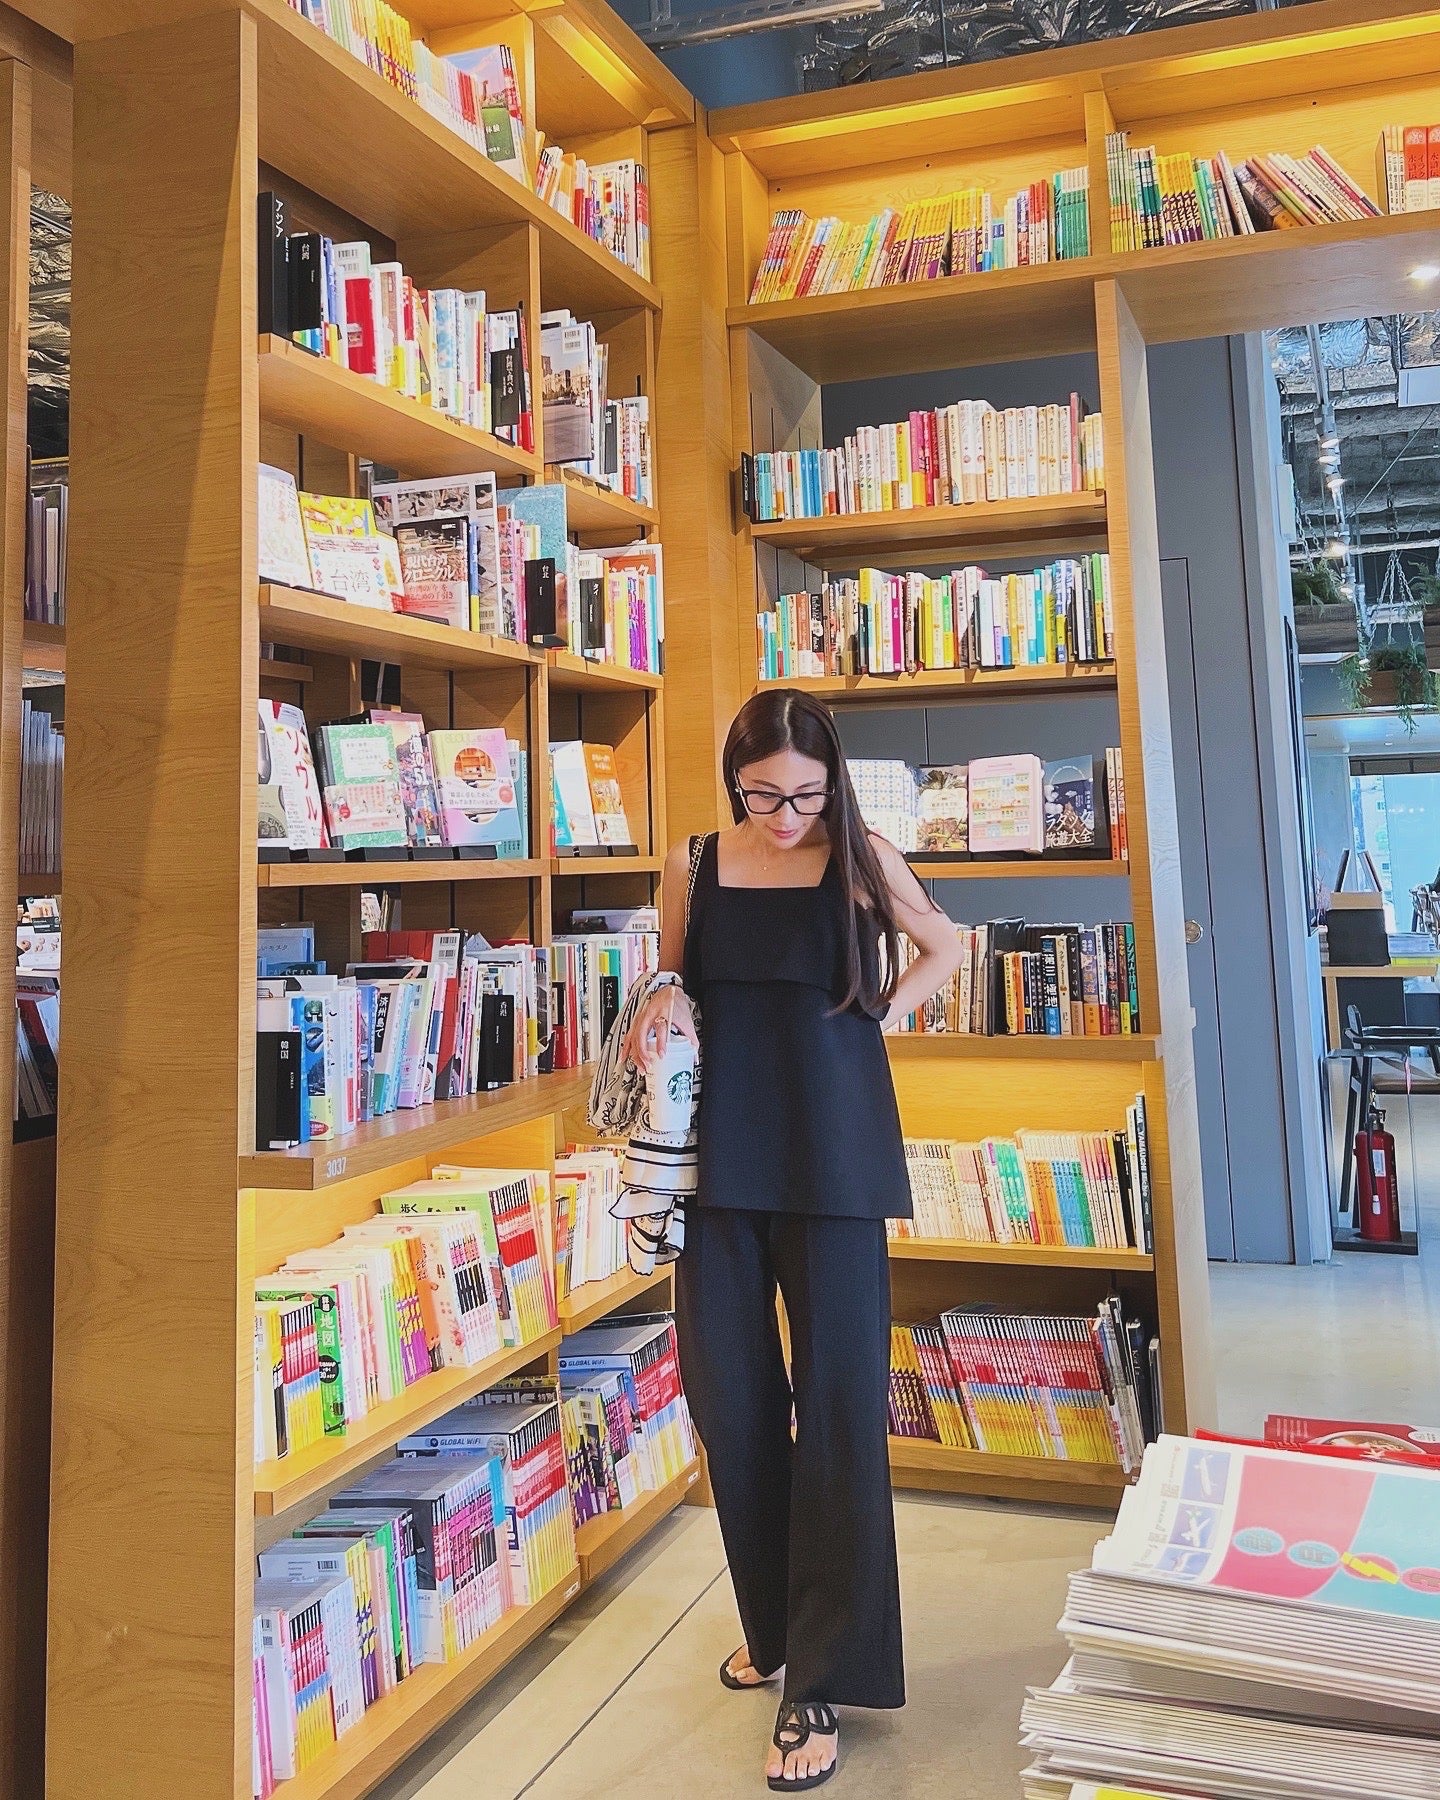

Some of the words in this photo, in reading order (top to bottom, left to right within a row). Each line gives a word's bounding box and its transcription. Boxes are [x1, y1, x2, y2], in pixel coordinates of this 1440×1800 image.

[275, 198, 284, 238] アジア
[329, 568, 370, 593] 台湾
[402, 564, 456, 583] クロニクル
[542, 565, 550, 579] 台北
[593, 583, 599, 596] タイ
[286, 730, 318, 822] ソウル
[1045, 809, 1092, 833] ラダック
[1045, 828, 1093, 848] 旅遊大全
[605, 982, 613, 1009] ベトナム
[375, 996, 389, 1038] 済州島で
[326, 1156, 347, 1178] 3037
[440, 1438, 465, 1446] GLOBAL
